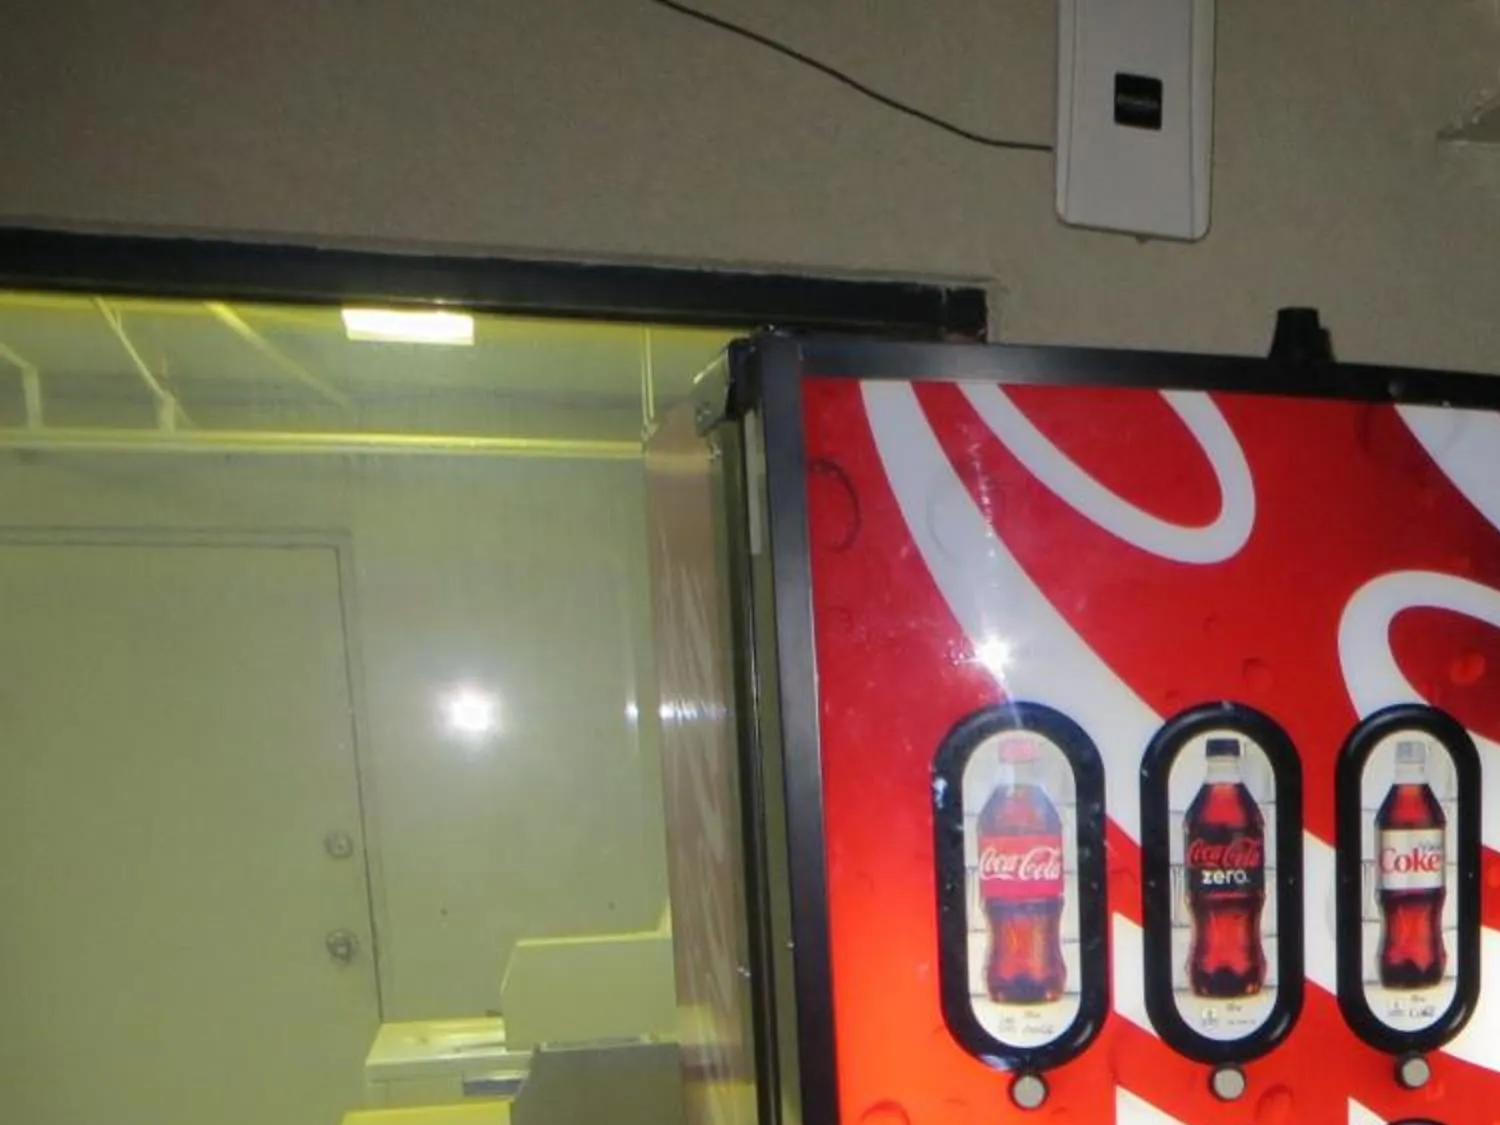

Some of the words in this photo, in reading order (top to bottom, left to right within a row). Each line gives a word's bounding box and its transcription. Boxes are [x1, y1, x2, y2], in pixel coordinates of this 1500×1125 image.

[979, 845, 1061, 882] Coca-Cola
[1379, 845, 1442, 875] Coke
[1201, 868, 1248, 886] zero
